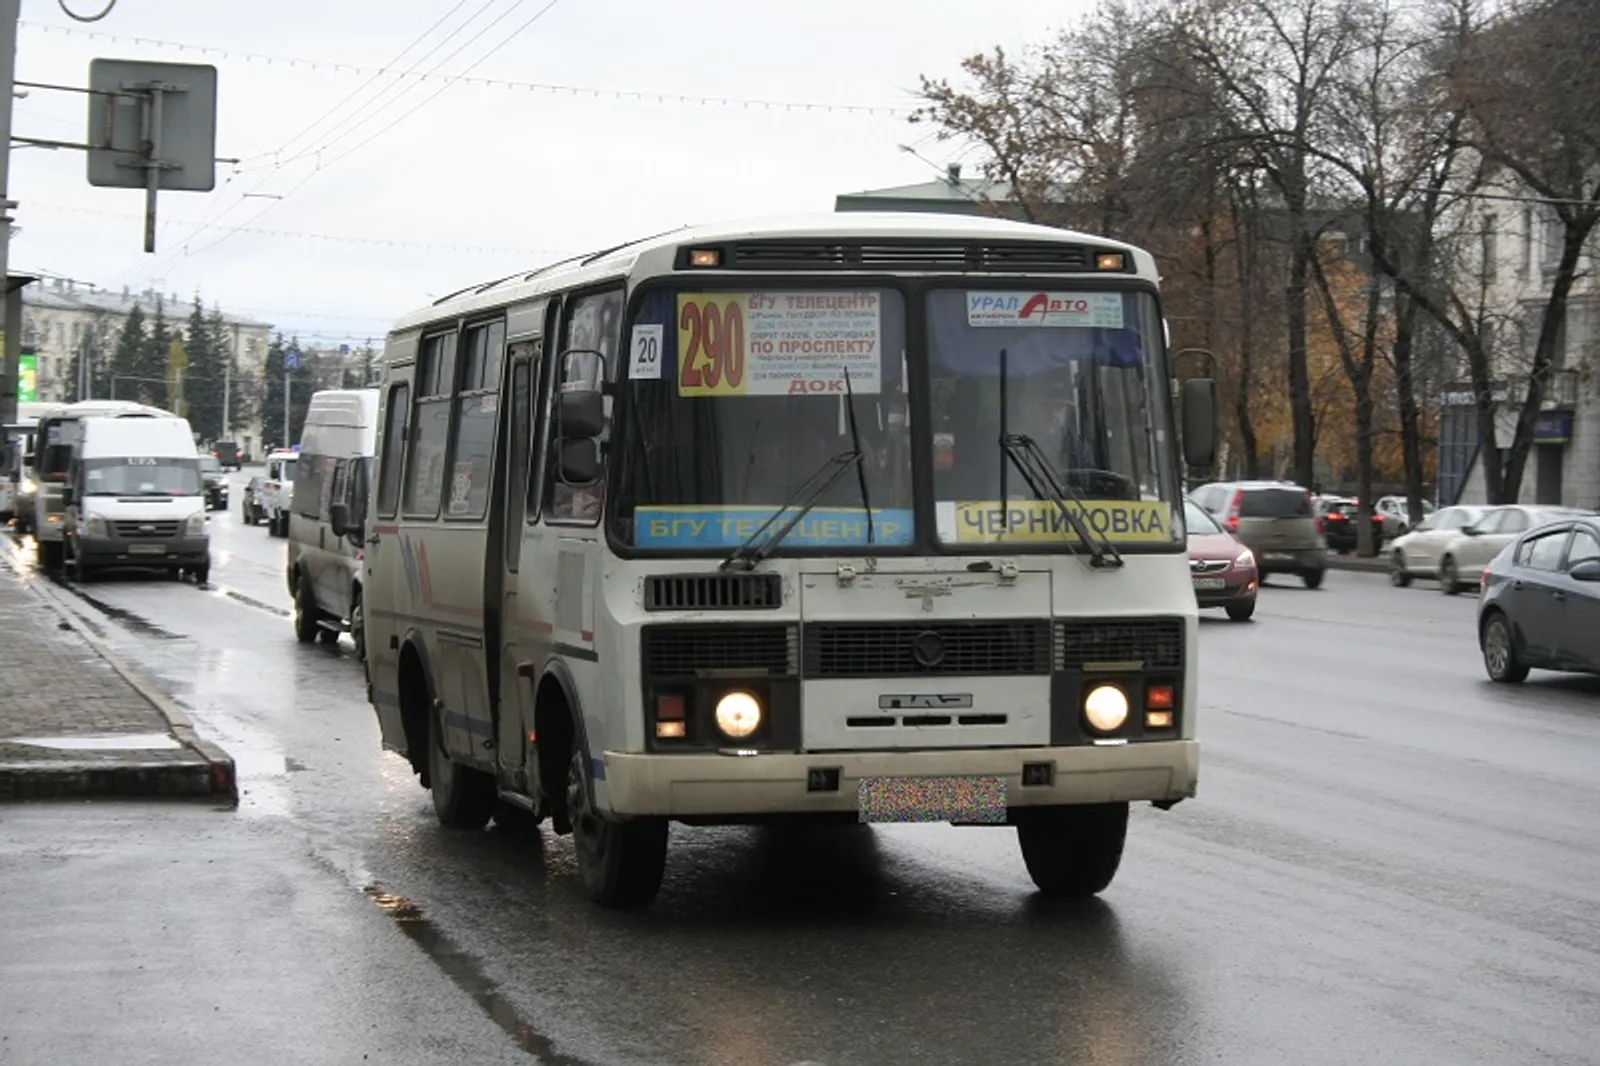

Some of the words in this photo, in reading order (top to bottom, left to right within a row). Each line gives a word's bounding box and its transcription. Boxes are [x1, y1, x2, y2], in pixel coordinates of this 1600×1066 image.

[748, 295, 776, 309] БГУ
[787, 295, 877, 310] ТЕЛЕЦЕНТР
[971, 296, 1018, 311] УРАЛ
[638, 336, 657, 363] 20
[680, 300, 744, 389] 290
[750, 340, 774, 353] ПО
[779, 339, 876, 353] ПРОСПЕКТУ
[788, 379, 845, 396] ДОК
[650, 519, 709, 538] БГУ
[963, 508, 1164, 534] ЧЕРНИКОВКА
